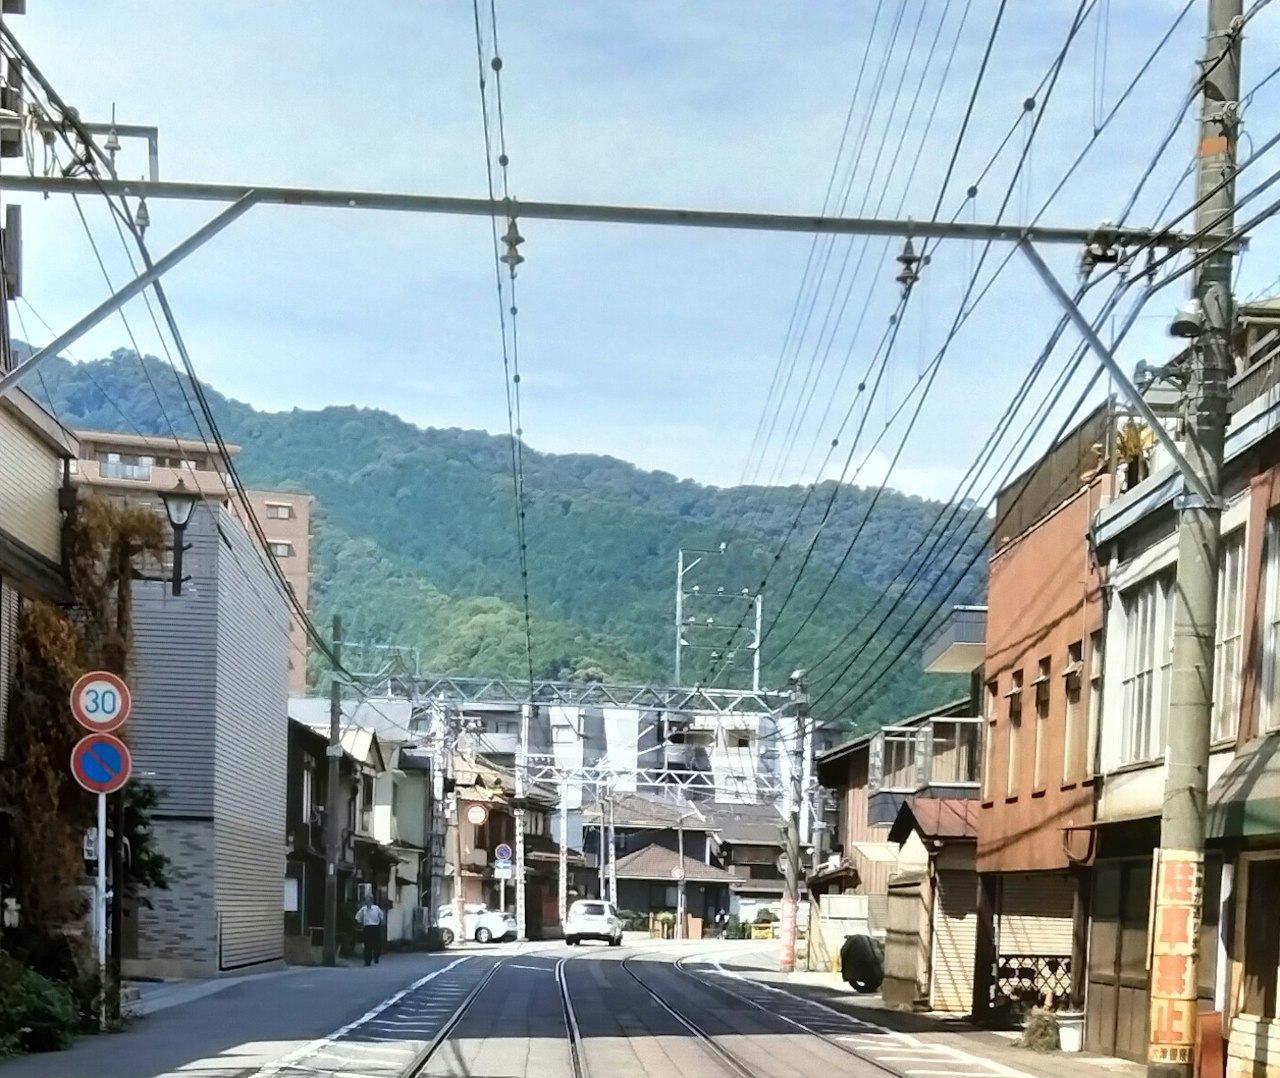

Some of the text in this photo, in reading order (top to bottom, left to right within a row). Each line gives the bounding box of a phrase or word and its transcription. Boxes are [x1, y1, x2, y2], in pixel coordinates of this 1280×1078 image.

[85, 689, 116, 714] 30
[1153, 860, 1194, 1043] 駐車禁止
